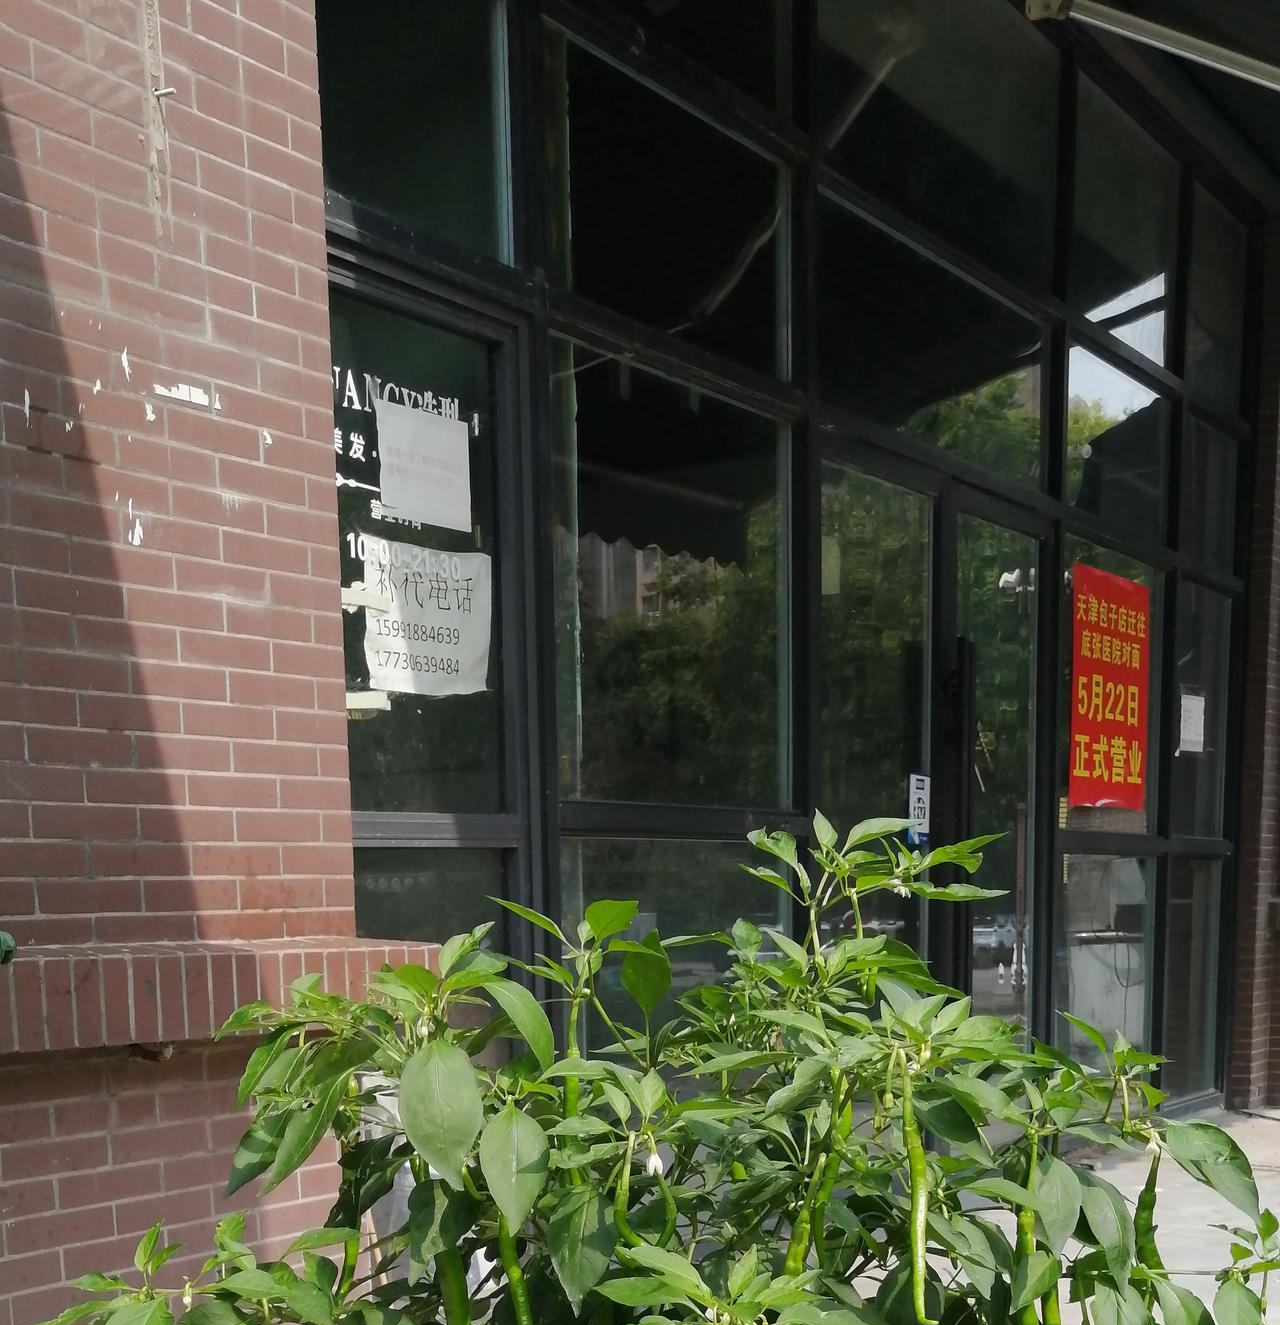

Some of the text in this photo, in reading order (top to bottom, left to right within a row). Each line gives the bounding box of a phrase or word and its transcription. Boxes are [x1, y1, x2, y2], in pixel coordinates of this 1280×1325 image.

[375, 618, 460, 645] 15991884639
[1077, 593, 1146, 638] 天津包子店迁往
[375, 650, 460, 675] 17730639484
[1081, 628, 1140, 670] 底张医院对面
[1078, 673, 1139, 728] 5月22日
[1072, 734, 1142, 785] 正式营业
